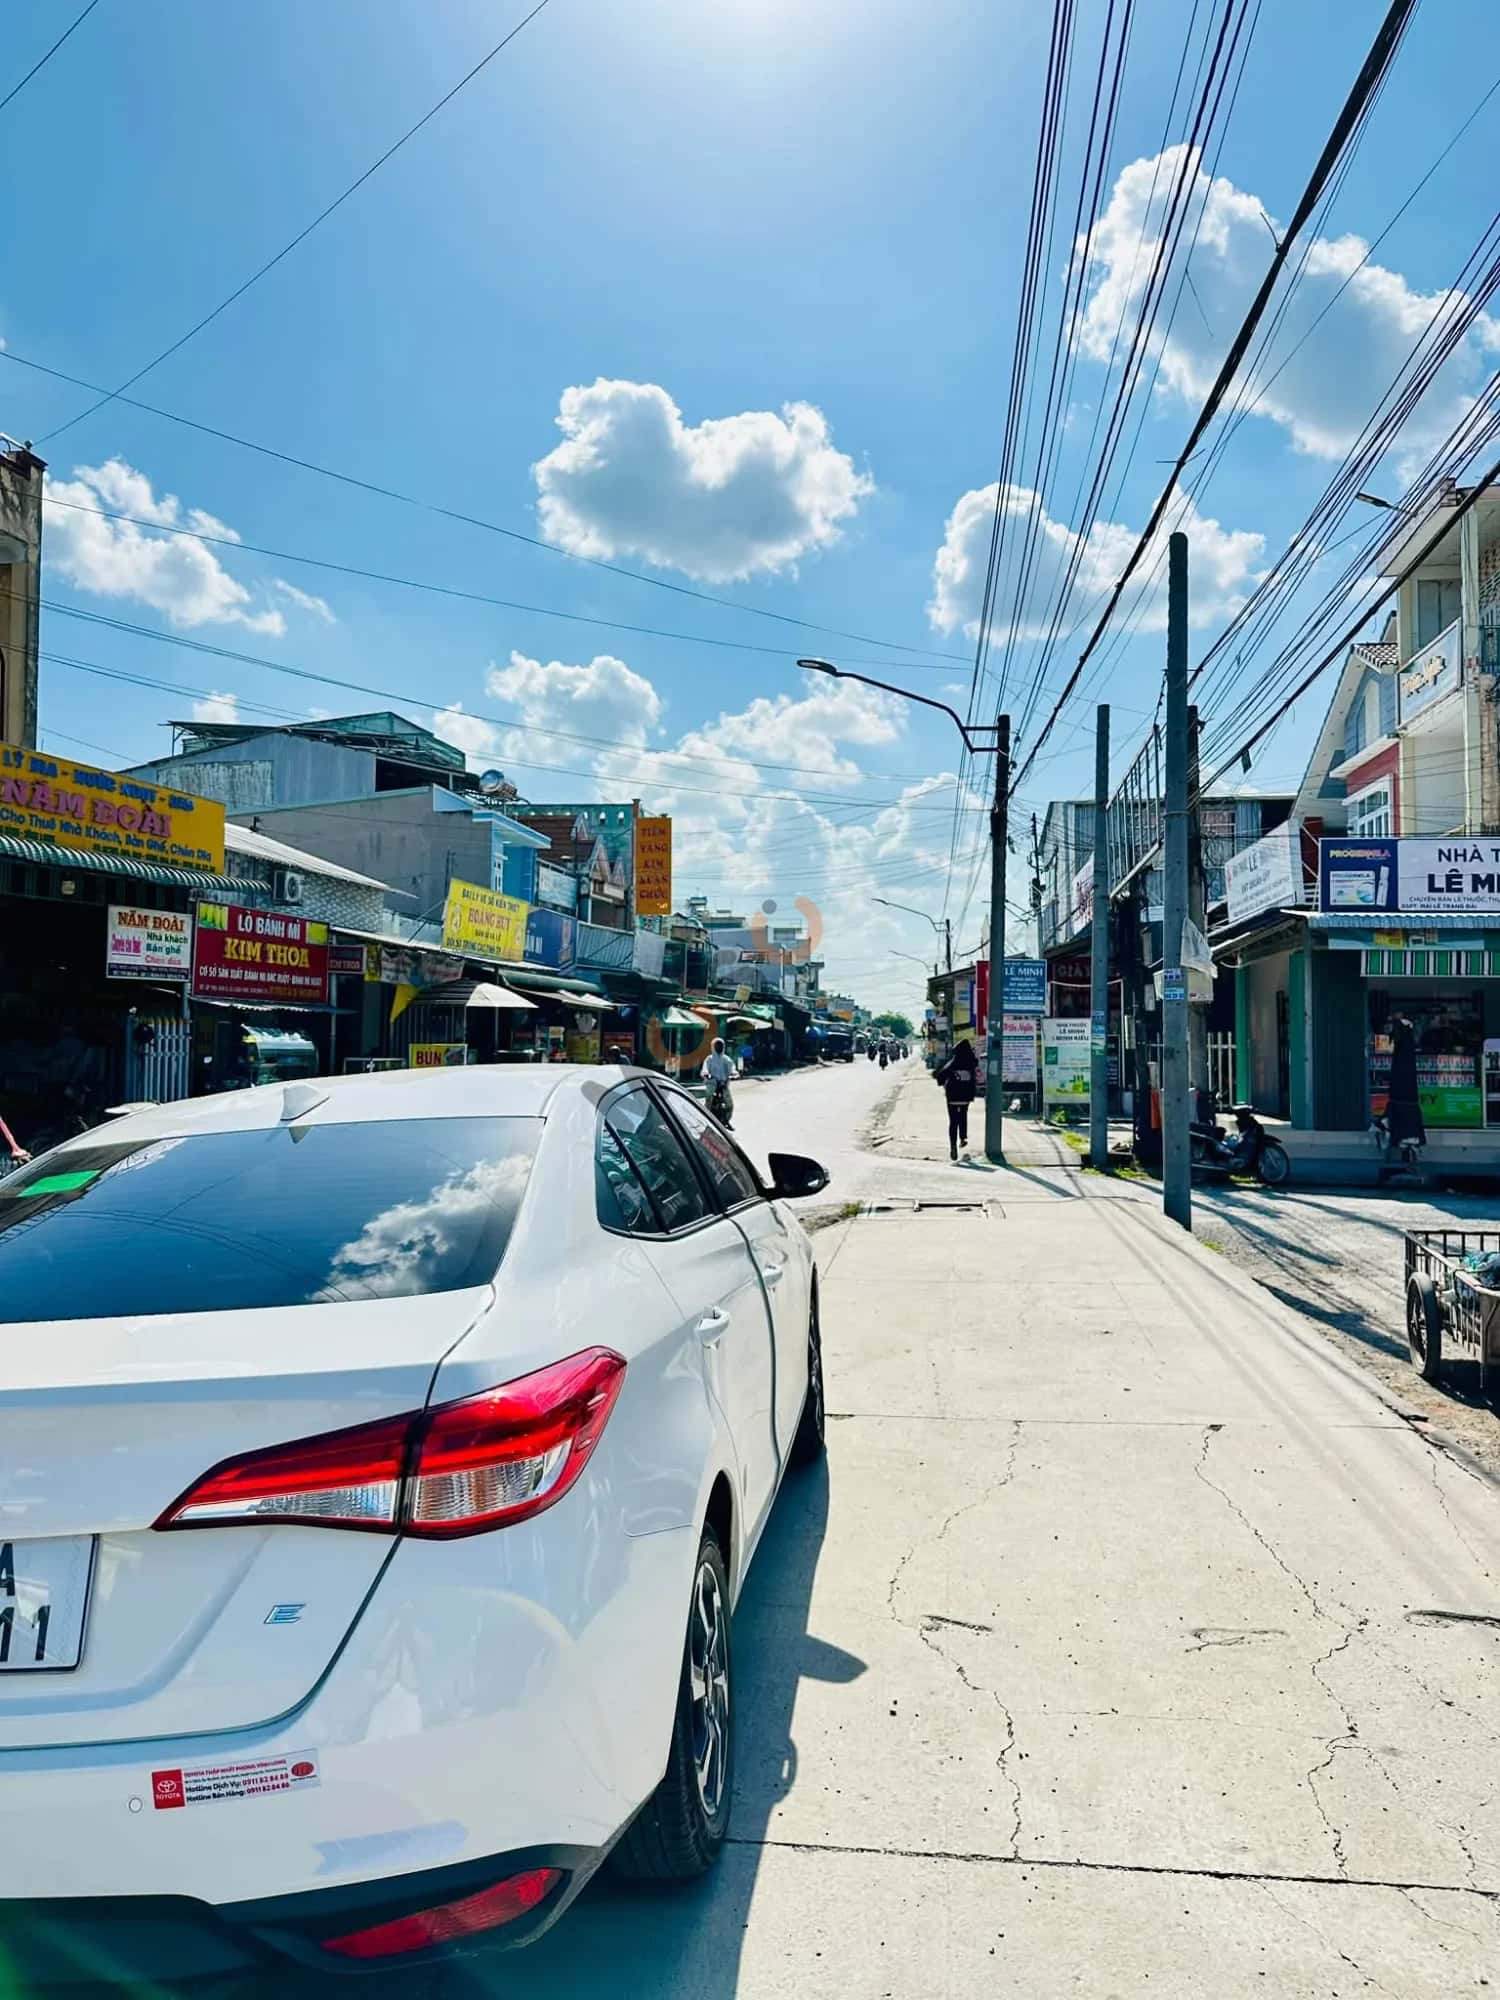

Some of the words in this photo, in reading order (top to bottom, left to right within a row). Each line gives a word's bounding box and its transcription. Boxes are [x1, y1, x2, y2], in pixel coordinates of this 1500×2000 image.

[1, 778, 86, 819] NĂM
[92, 797, 172, 838] ĐOÀI
[30, 814, 56, 830] Thuê
[60, 819, 82, 835] Nhà
[1438, 844, 1483, 862] NHÀ
[1428, 868, 1463, 893] LÊ
[118, 910, 149, 928] NĂM
[152, 915, 184, 932] ĐOÀI
[238, 911, 253, 933] LÒ
[255, 914, 285, 938] BÁNH
[288, 919, 301, 940] MÌ
[147, 931, 162, 941] Nhà
[165, 933, 188, 944] khách
[146, 943, 162, 952] Bàn
[166, 944, 181, 955] ghế
[224, 938, 262, 963] KIM
[266, 943, 310, 968] THOA
[1018, 967, 1043, 976] MINH
[263, 1604, 306, 1625] E
[186, 1784, 212, 1793] Hotline
[213, 1782, 229, 1792] Dịch
[230, 1780, 241, 1788] Vụ:
[242, 1777, 258, 1786] 0911
[187, 1793, 212, 1802] Hotline
[212, 1791, 226, 1800] Bán
[226, 1788, 246, 1798] Hàng:
[247, 1786, 262, 1795] 0911
